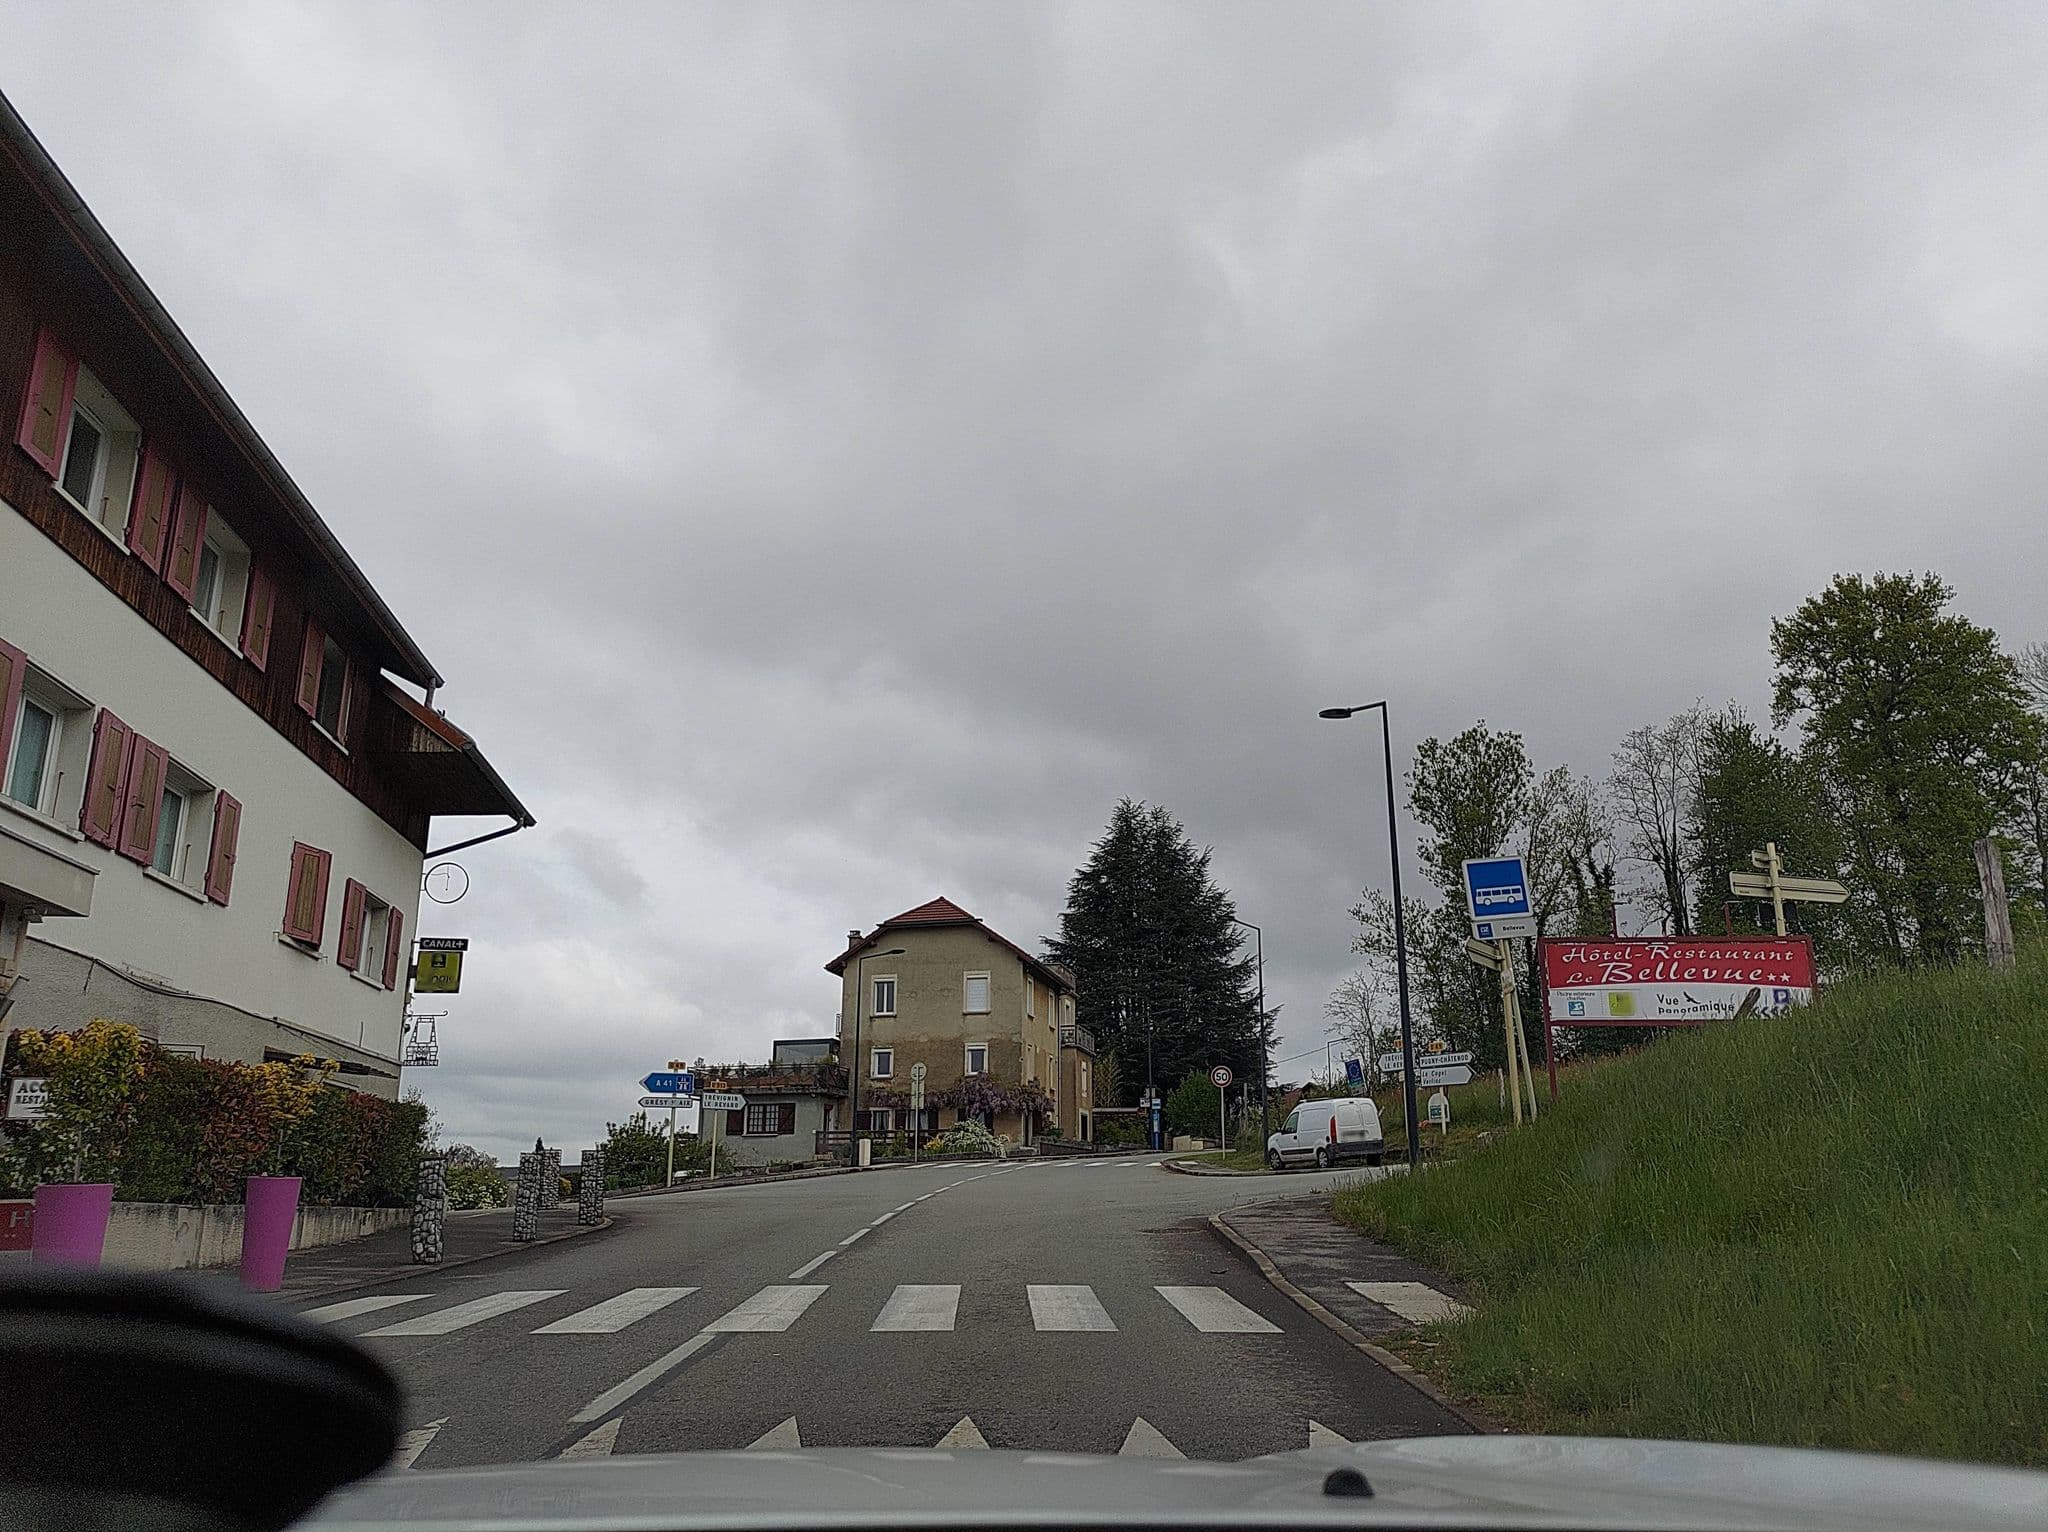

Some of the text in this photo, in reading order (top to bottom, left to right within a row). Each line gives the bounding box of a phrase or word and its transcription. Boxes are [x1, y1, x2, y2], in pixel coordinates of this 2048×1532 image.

[421, 938, 465, 949] CANAL+
[1565, 960, 1764, 985] Le Bellevue
[1656, 993, 1679, 1007] Vue
[1658, 1003, 1736, 1016] panoramique
[1215, 1072, 1228, 1081] 50
[656, 1079, 673, 1087] A 41
[679, 1098, 692, 1106] AIX
